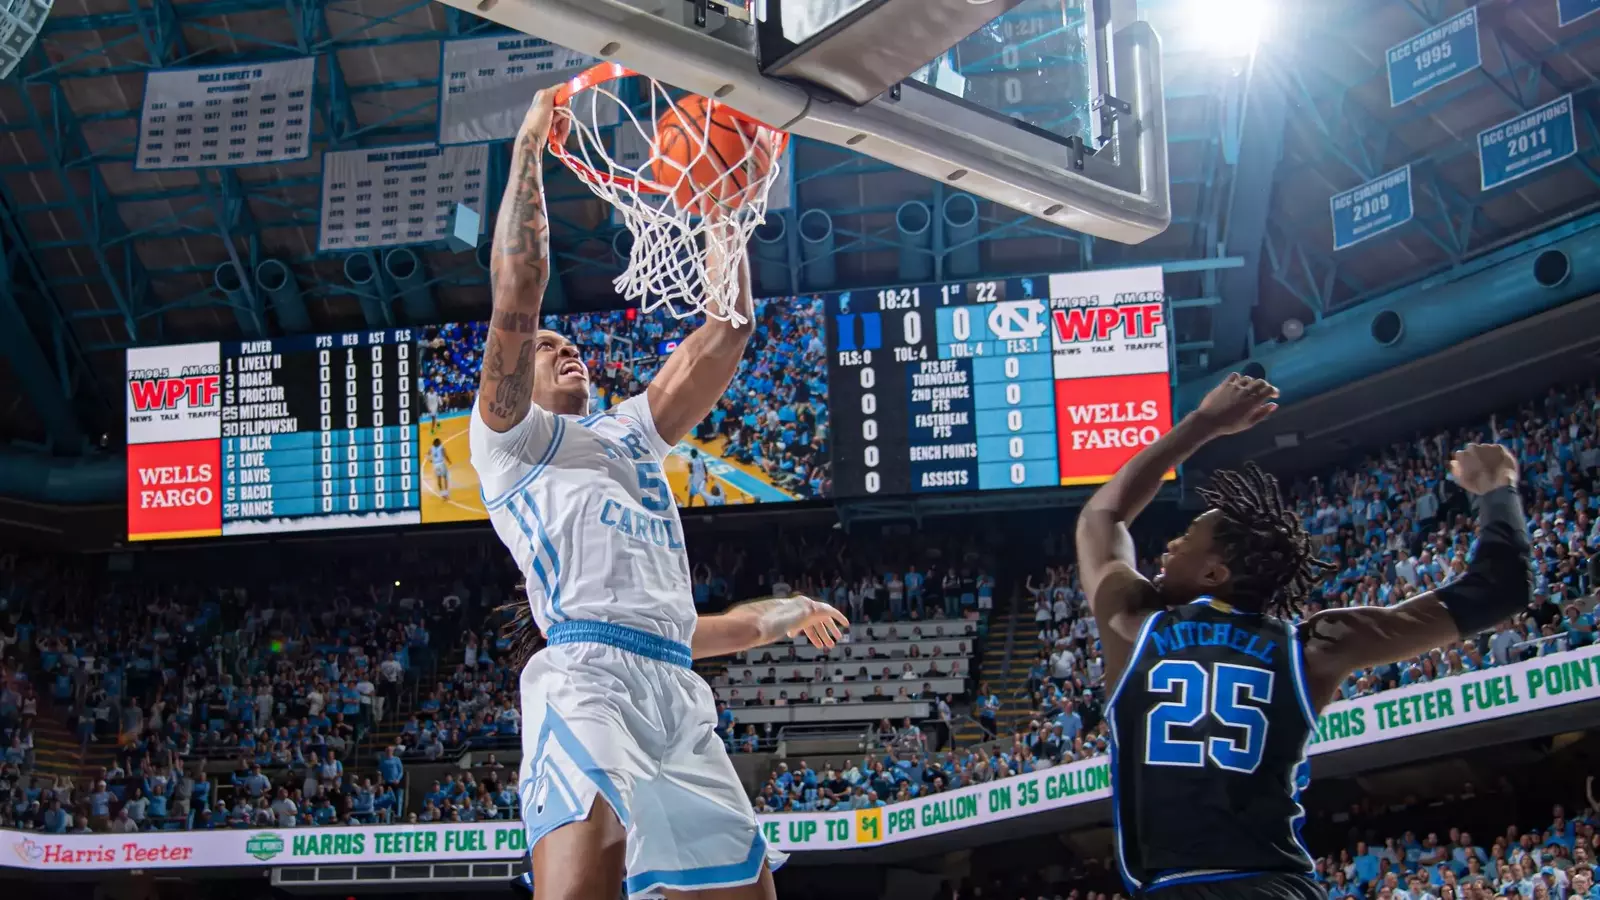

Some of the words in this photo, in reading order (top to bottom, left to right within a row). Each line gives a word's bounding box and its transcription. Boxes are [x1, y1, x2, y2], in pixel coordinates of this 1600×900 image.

[1391, 45, 1411, 63] ACC
[1412, 13, 1473, 52] CHAMPIONS
[1414, 41, 1452, 71] 1995
[1483, 129, 1504, 147] ACC
[1505, 102, 1568, 138] CHAMPIONS
[1507, 128, 1547, 157] 2011
[878, 287, 920, 310] 18:21
[976, 281, 997, 303] 22
[1051, 298, 1070, 308] FM
[1071, 296, 1099, 307] 98.5
[1114, 293, 1138, 304] AM
[1139, 292, 1162, 303] 680
[903, 310, 922, 345] 0
[953, 307, 970, 341] 0
[1053, 303, 1163, 344] WPTF
[241, 341, 272, 354] PLAYER
[316, 335, 332, 348] PTS
[342, 334, 358, 346] REB
[369, 331, 385, 344] AST
[395, 329, 411, 342] FLS
[1054, 348, 1081, 356] NEWS
[1092, 345, 1115, 353] TALK
[1125, 342, 1163, 351] TRAFFIC
[227, 358, 232, 372] 1
[239, 355, 272, 371] LIVELY
[273, 354, 282, 368] II
[320, 349, 330, 365] 0
[347, 348, 354, 363] 1
[372, 346, 382, 361] 0
[398, 343, 408, 359] 0
[921, 361, 939, 374] PTS
[940, 360, 957, 373] OFF
[1005, 357, 1019, 378] 0
[129, 369, 144, 380] FM
[145, 367, 169, 379] 98.5
[181, 366, 200, 376] AM
[200, 364, 220, 374] 680
[225, 374, 234, 388] 3
[239, 371, 272, 387] ROACH
[320, 366, 330, 381] 0
[346, 364, 356, 380] 0
[372, 362, 382, 378] 0
[399, 360, 408, 376] 0
[860, 367, 875, 388] 0
[913, 371, 966, 386] TURNOVERS
[130, 374, 220, 411] WPTF
[225, 390, 234, 404] 5
[239, 386, 284, 403] PROCTOR
[320, 382, 330, 398] 0
[346, 380, 356, 396] 0
[373, 378, 382, 394] 0
[399, 376, 409, 392] 0
[912, 388, 931, 401] 2ND
[933, 386, 969, 400] CHANCE
[1007, 384, 1020, 404] 0
[188, 411, 221, 419] TRAFFIC
[222, 406, 238, 420] 25
[239, 402, 289, 419] MITCHELL
[321, 398, 330, 414] 0
[347, 396, 357, 412] 0
[373, 394, 383, 410] 0
[399, 392, 409, 408] 0
[862, 393, 876, 414] 0
[932, 399, 950, 412] PTS
[1068, 400, 1158, 424] WELLS
[222, 422, 238, 436] 30
[240, 418, 297, 435] FILIPOWSKI
[321, 415, 331, 430] 0
[347, 413, 357, 429] 0
[373, 411, 383, 427] 0
[400, 409, 410, 425] 0
[863, 419, 878, 441] 0
[916, 412, 968, 427] FASTBREAK
[933, 425, 952, 438] PTS
[1008, 410, 1022, 431] 0
[228, 439, 233, 452] 1
[240, 436, 272, 451] BLACK
[321, 431, 331, 446] 0
[349, 429, 355, 444] 1
[374, 427, 383, 442] 0
[400, 425, 409, 440] 0
[1009, 437, 1023, 458] 0
[1072, 426, 1160, 450] FARGO
[227, 455, 235, 468] 2
[240, 453, 264, 467] LOVE
[322, 447, 331, 462] 0
[348, 445, 357, 460] 0
[374, 444, 383, 459] 0
[401, 442, 410, 457] 0
[864, 445, 879, 467] 0
[910, 445, 941, 461] BENCH
[942, 443, 977, 459] POINTS
[138, 464, 212, 486] WELLS
[228, 471, 235, 484] 4
[240, 468, 270, 484] DAVIS
[322, 463, 331, 479] 0
[348, 462, 357, 477] 0
[375, 460, 384, 475] 0
[401, 458, 410, 473] 0
[865, 472, 880, 493] 0
[922, 470, 968, 487] ASSISTS
[1011, 463, 1025, 484] 0
[141, 487, 213, 509] FARGO
[227, 487, 235, 500] 5
[241, 484, 272, 500] BACOT
[323, 480, 331, 495] 0
[350, 479, 356, 493] 1
[375, 476, 384, 491] 0
[402, 475, 411, 490] 0
[635, 462, 671, 511] 5
[224, 503, 239, 517] 32
[241, 501, 274, 516] NANCE
[323, 496, 332, 512] 0
[349, 495, 358, 510] 0
[375, 493, 384, 508] 0
[403, 492, 409, 507] 1
[600, 498, 683, 550] CAROL
[1151, 621, 1279, 664] MITCHELL
[1374, 687, 1455, 730] TEETER
[1462, 674, 1519, 712] FUEL
[1145, 659, 1275, 774] 25
[789, 820, 817, 843] UP
[825, 818, 849, 841] TO
[861, 816, 878, 839] $1
[888, 811, 915, 834] PER
[922, 797, 978, 826] GALLON
[989, 787, 1011, 813] ON
[1017, 780, 1039, 806] 35
[42, 844, 116, 864] Harris
[122, 842, 193, 863] Teeter
[292, 833, 365, 856] HARRIS
[374, 830, 438, 854] TEETER
[444, 829, 487, 852] FUEL
